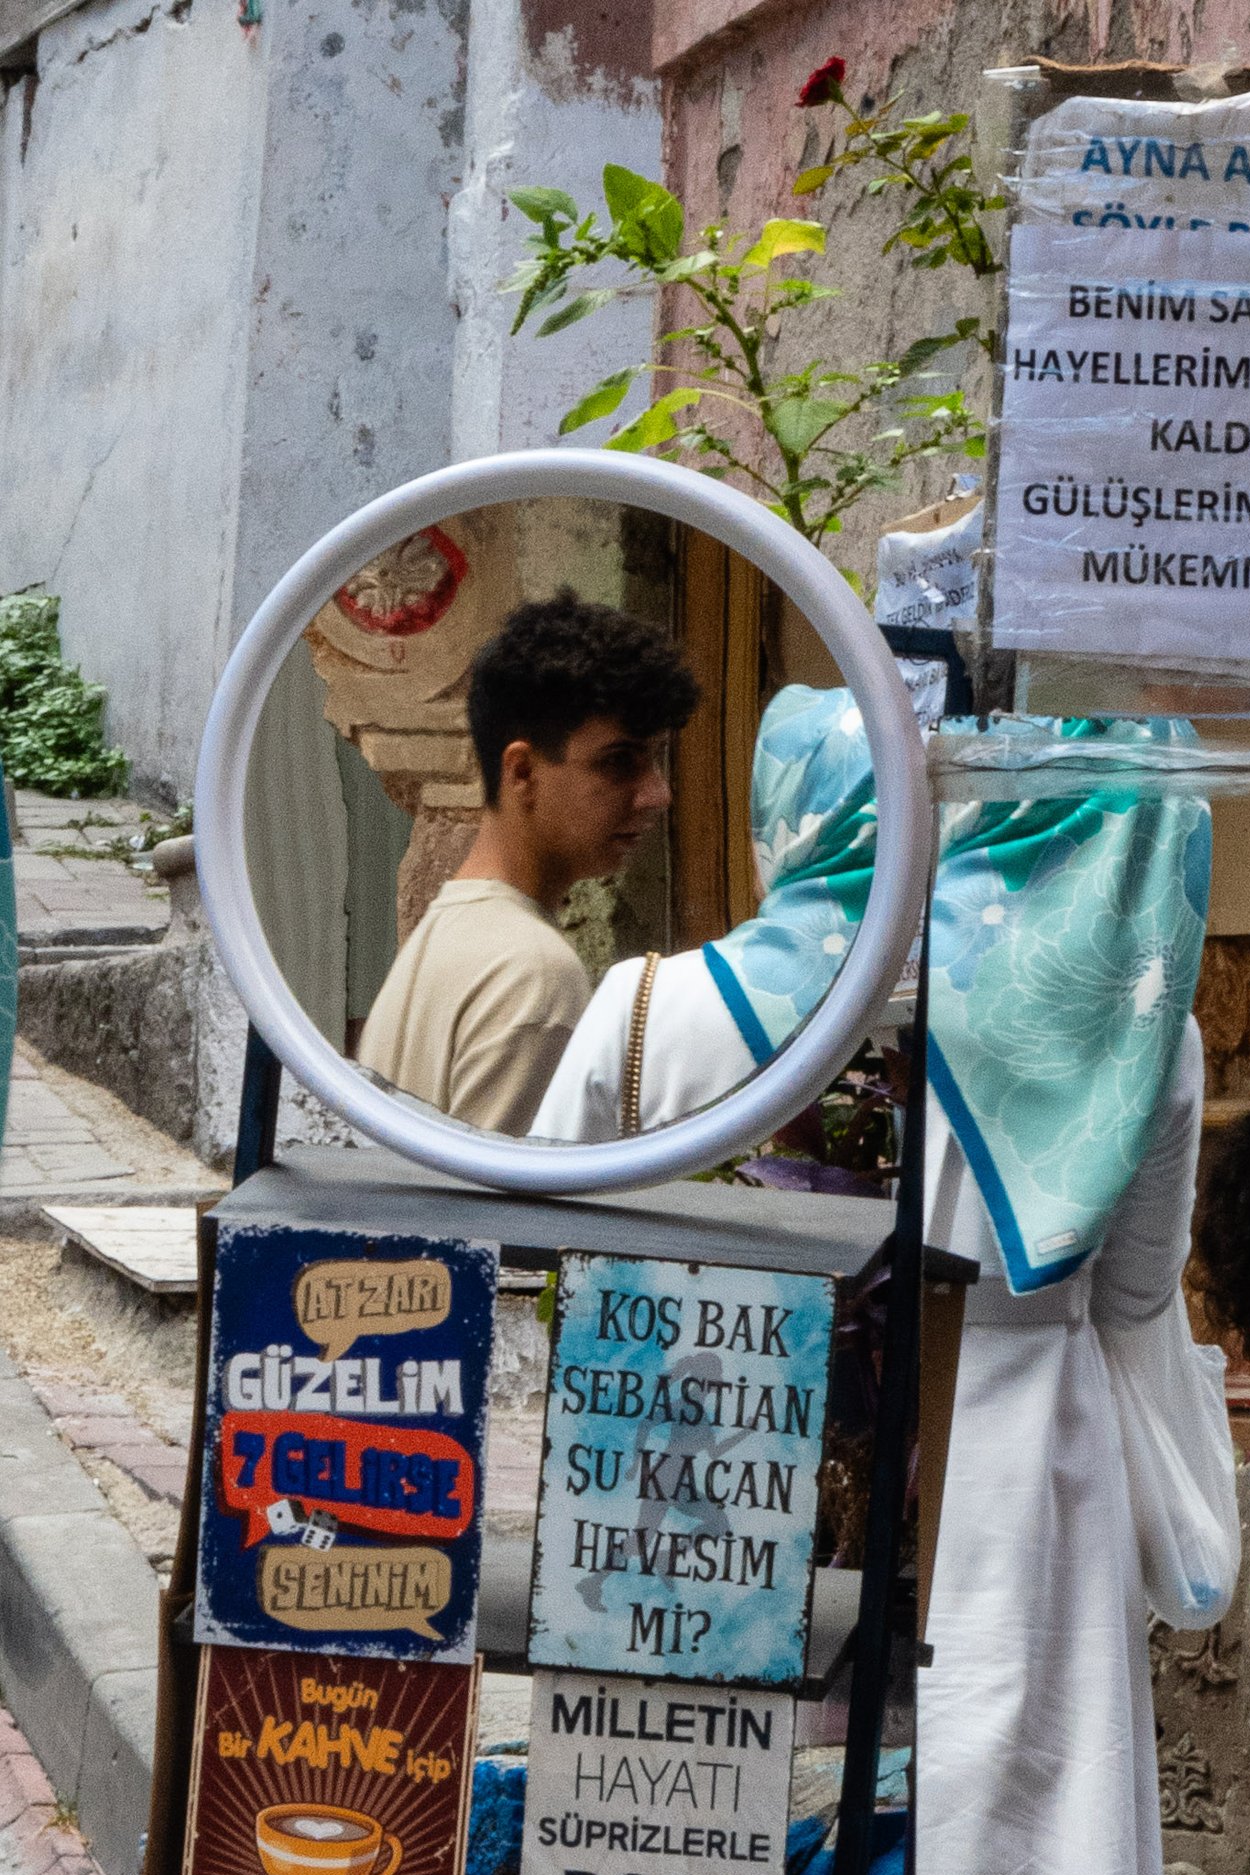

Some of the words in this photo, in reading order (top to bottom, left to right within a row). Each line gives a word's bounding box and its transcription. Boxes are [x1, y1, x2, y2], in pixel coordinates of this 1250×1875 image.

[1081, 139, 1210, 180] AYNA
[1068, 279, 1195, 323] BENİM
[303, 1274, 353, 1324] AT
[597, 1289, 684, 1351] KOŞ
[695, 1300, 793, 1358] BAK
[223, 1344, 464, 1415] GÜZELİM
[562, 1365, 814, 1438] SEBASTİAN
[232, 1430, 266, 1488] 7
[271, 1431, 461, 1519] GELİRSE
[637, 1450, 797, 1513] KAÇAN
[570, 1519, 779, 1590] HEVESİM
[626, 1602, 711, 1656] Mİ?
[300, 1678, 379, 1713] Bugün
[552, 1687, 772, 1750] MİLLETİN
[218, 1731, 252, 1759] Bir
[257, 1716, 404, 1775] KAHVE
[576, 1752, 741, 1812] HAYATI
[538, 1812, 771, 1862] SÜPRİZLERLE
